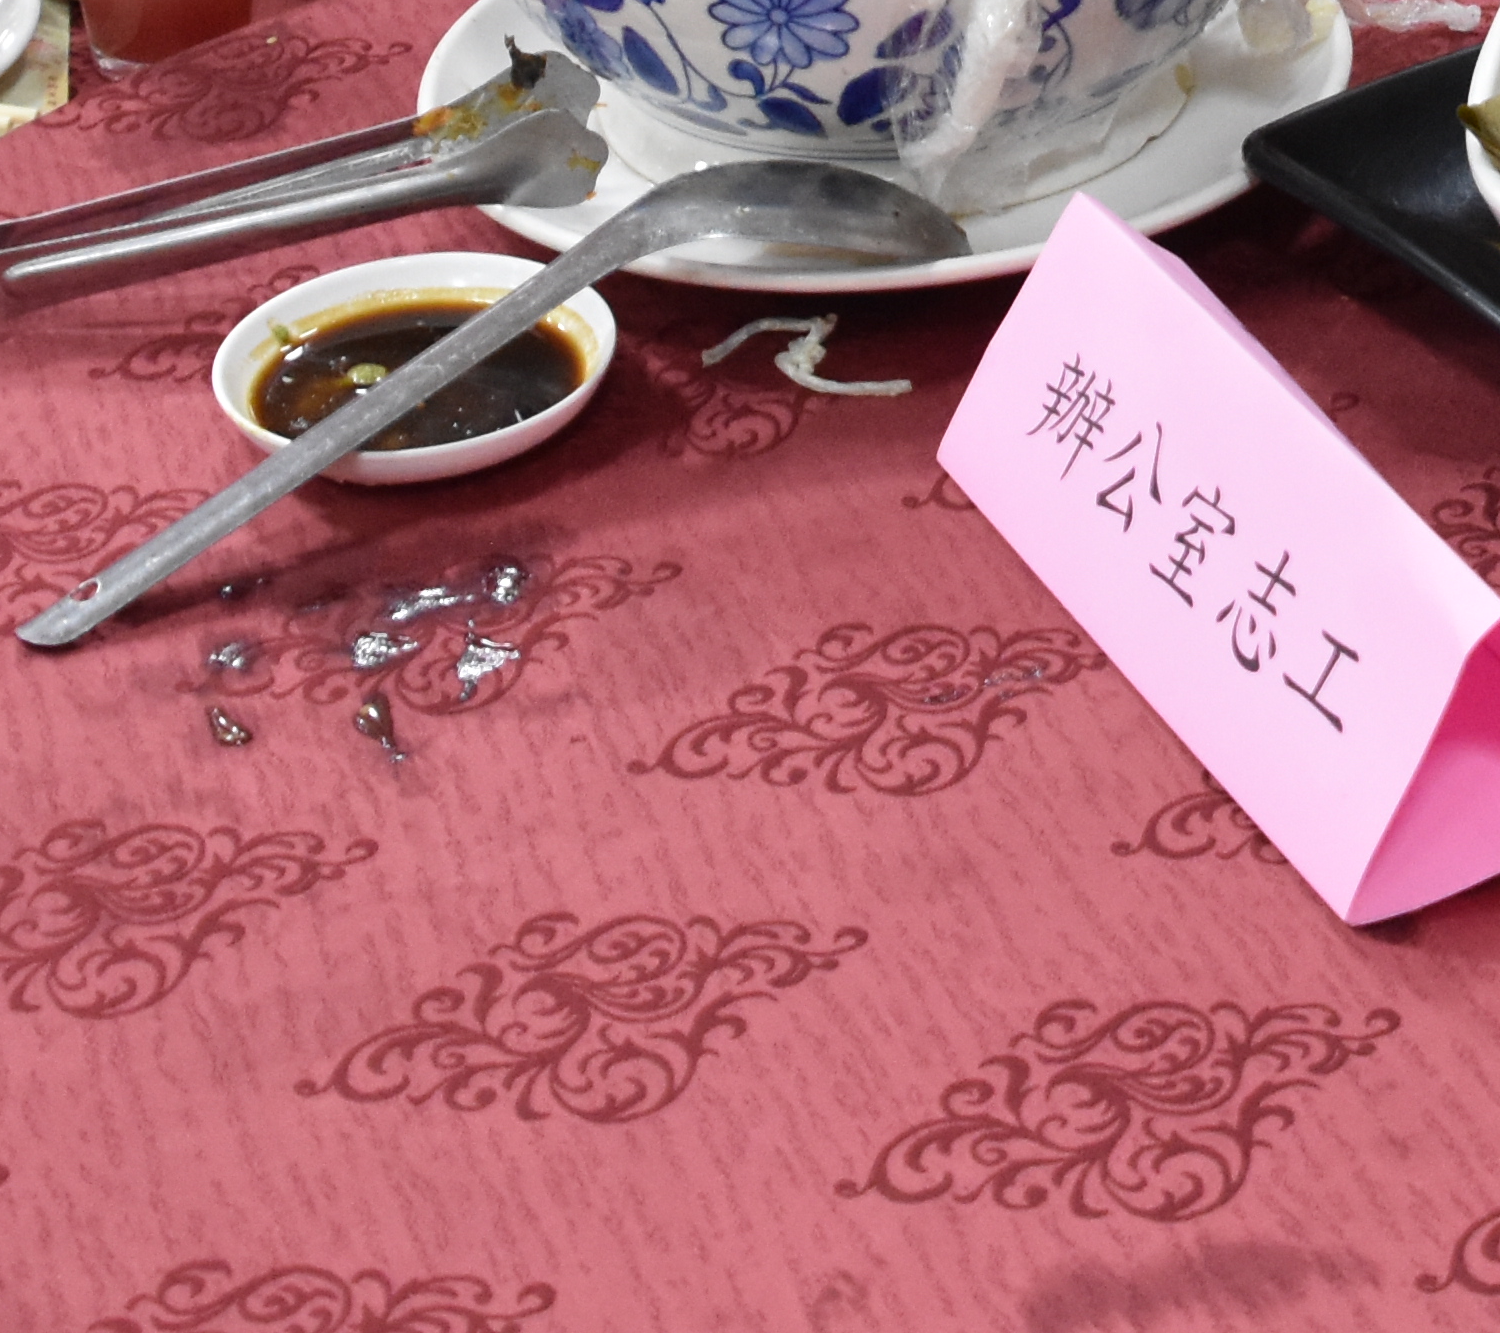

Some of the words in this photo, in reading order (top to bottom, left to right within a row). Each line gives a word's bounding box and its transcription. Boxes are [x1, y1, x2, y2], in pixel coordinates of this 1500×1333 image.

[1026, 353, 1359, 734] 辦公室志工
